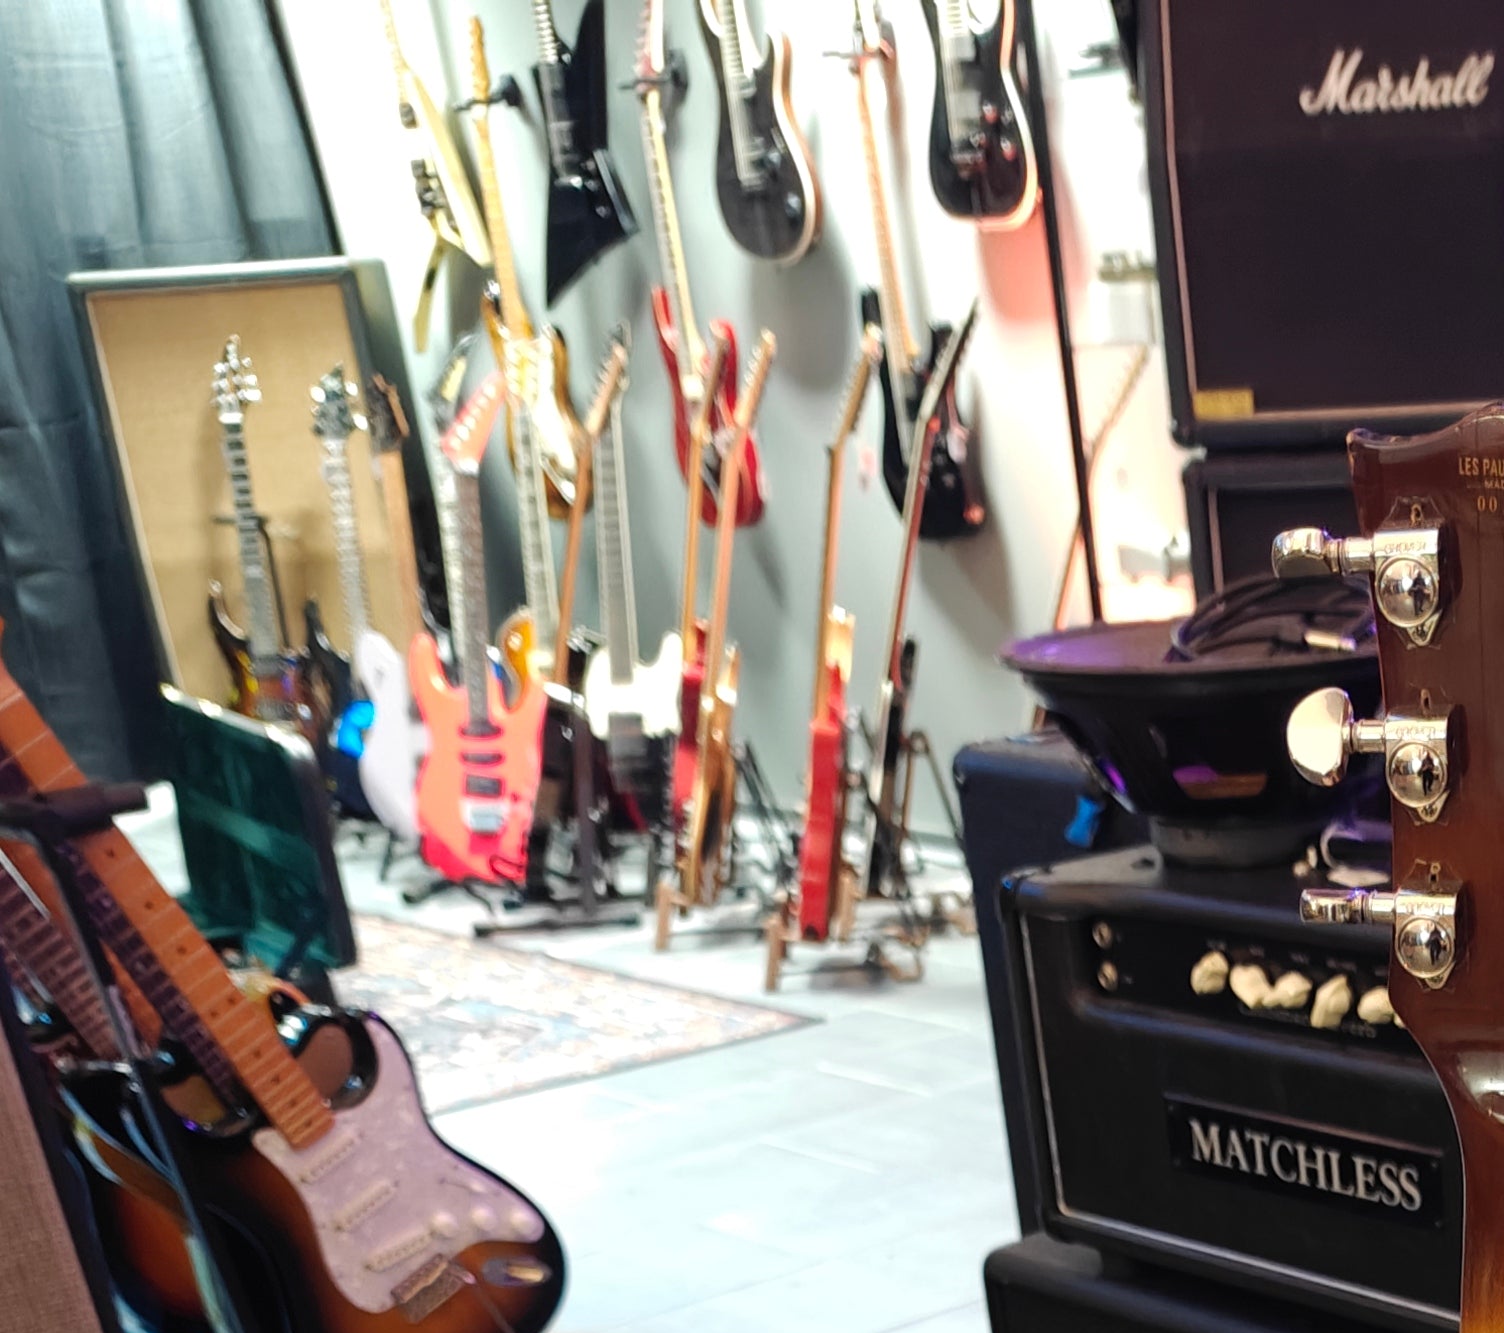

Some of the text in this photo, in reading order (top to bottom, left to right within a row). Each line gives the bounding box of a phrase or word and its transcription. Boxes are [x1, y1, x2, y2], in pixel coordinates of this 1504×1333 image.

[1299, 47, 1495, 116] Marshall
[1458, 456, 1479, 476] LES
[1189, 1118, 1422, 1211] MATCHLESS
